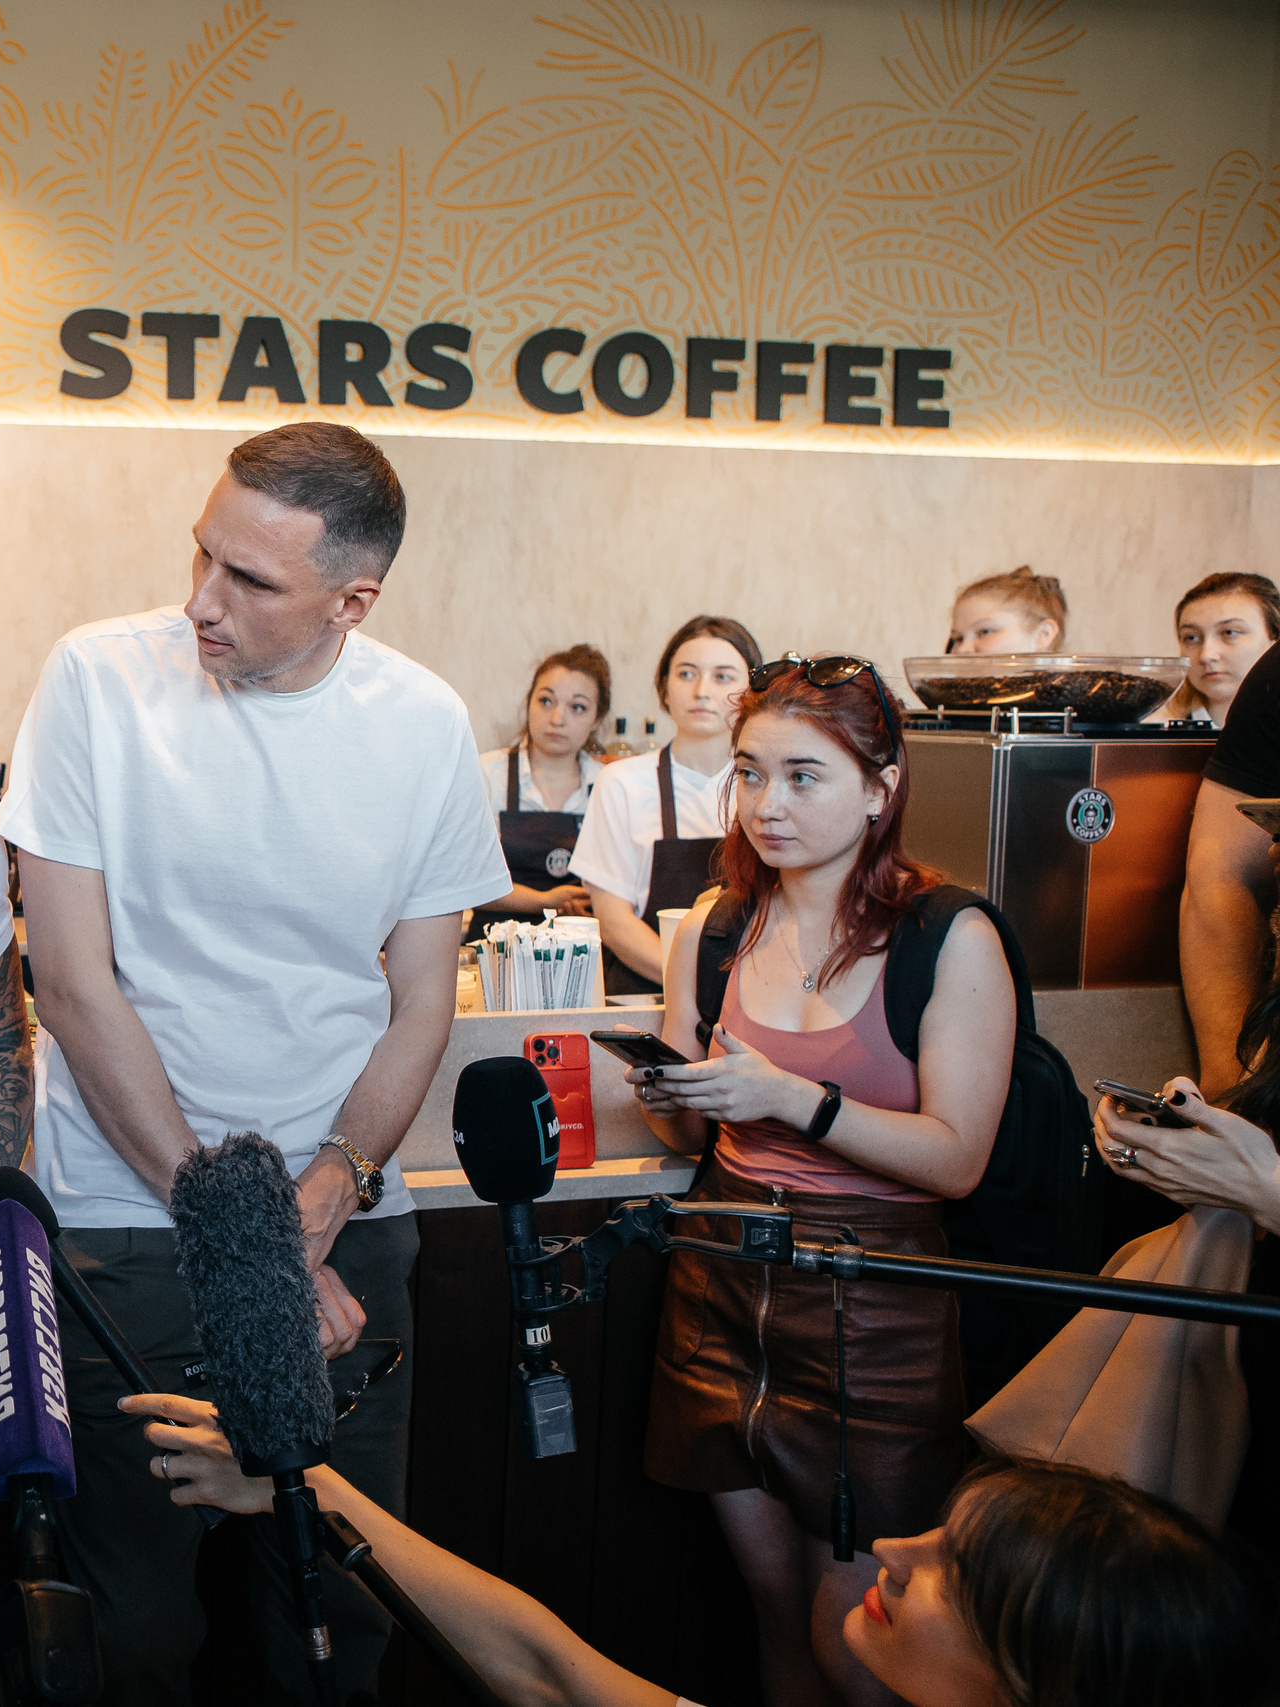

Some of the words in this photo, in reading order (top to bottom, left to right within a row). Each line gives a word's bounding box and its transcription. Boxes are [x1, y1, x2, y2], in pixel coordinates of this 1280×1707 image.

[59, 308, 474, 411] STARS
[515, 327, 953, 428] COFFEE
[1078, 793, 1106, 805] STARS
[1075, 826, 1104, 838] COFFEE
[25, 1247, 72, 1439] ИЗВЕСТИЯ
[531, 1327, 548, 1343] 10
